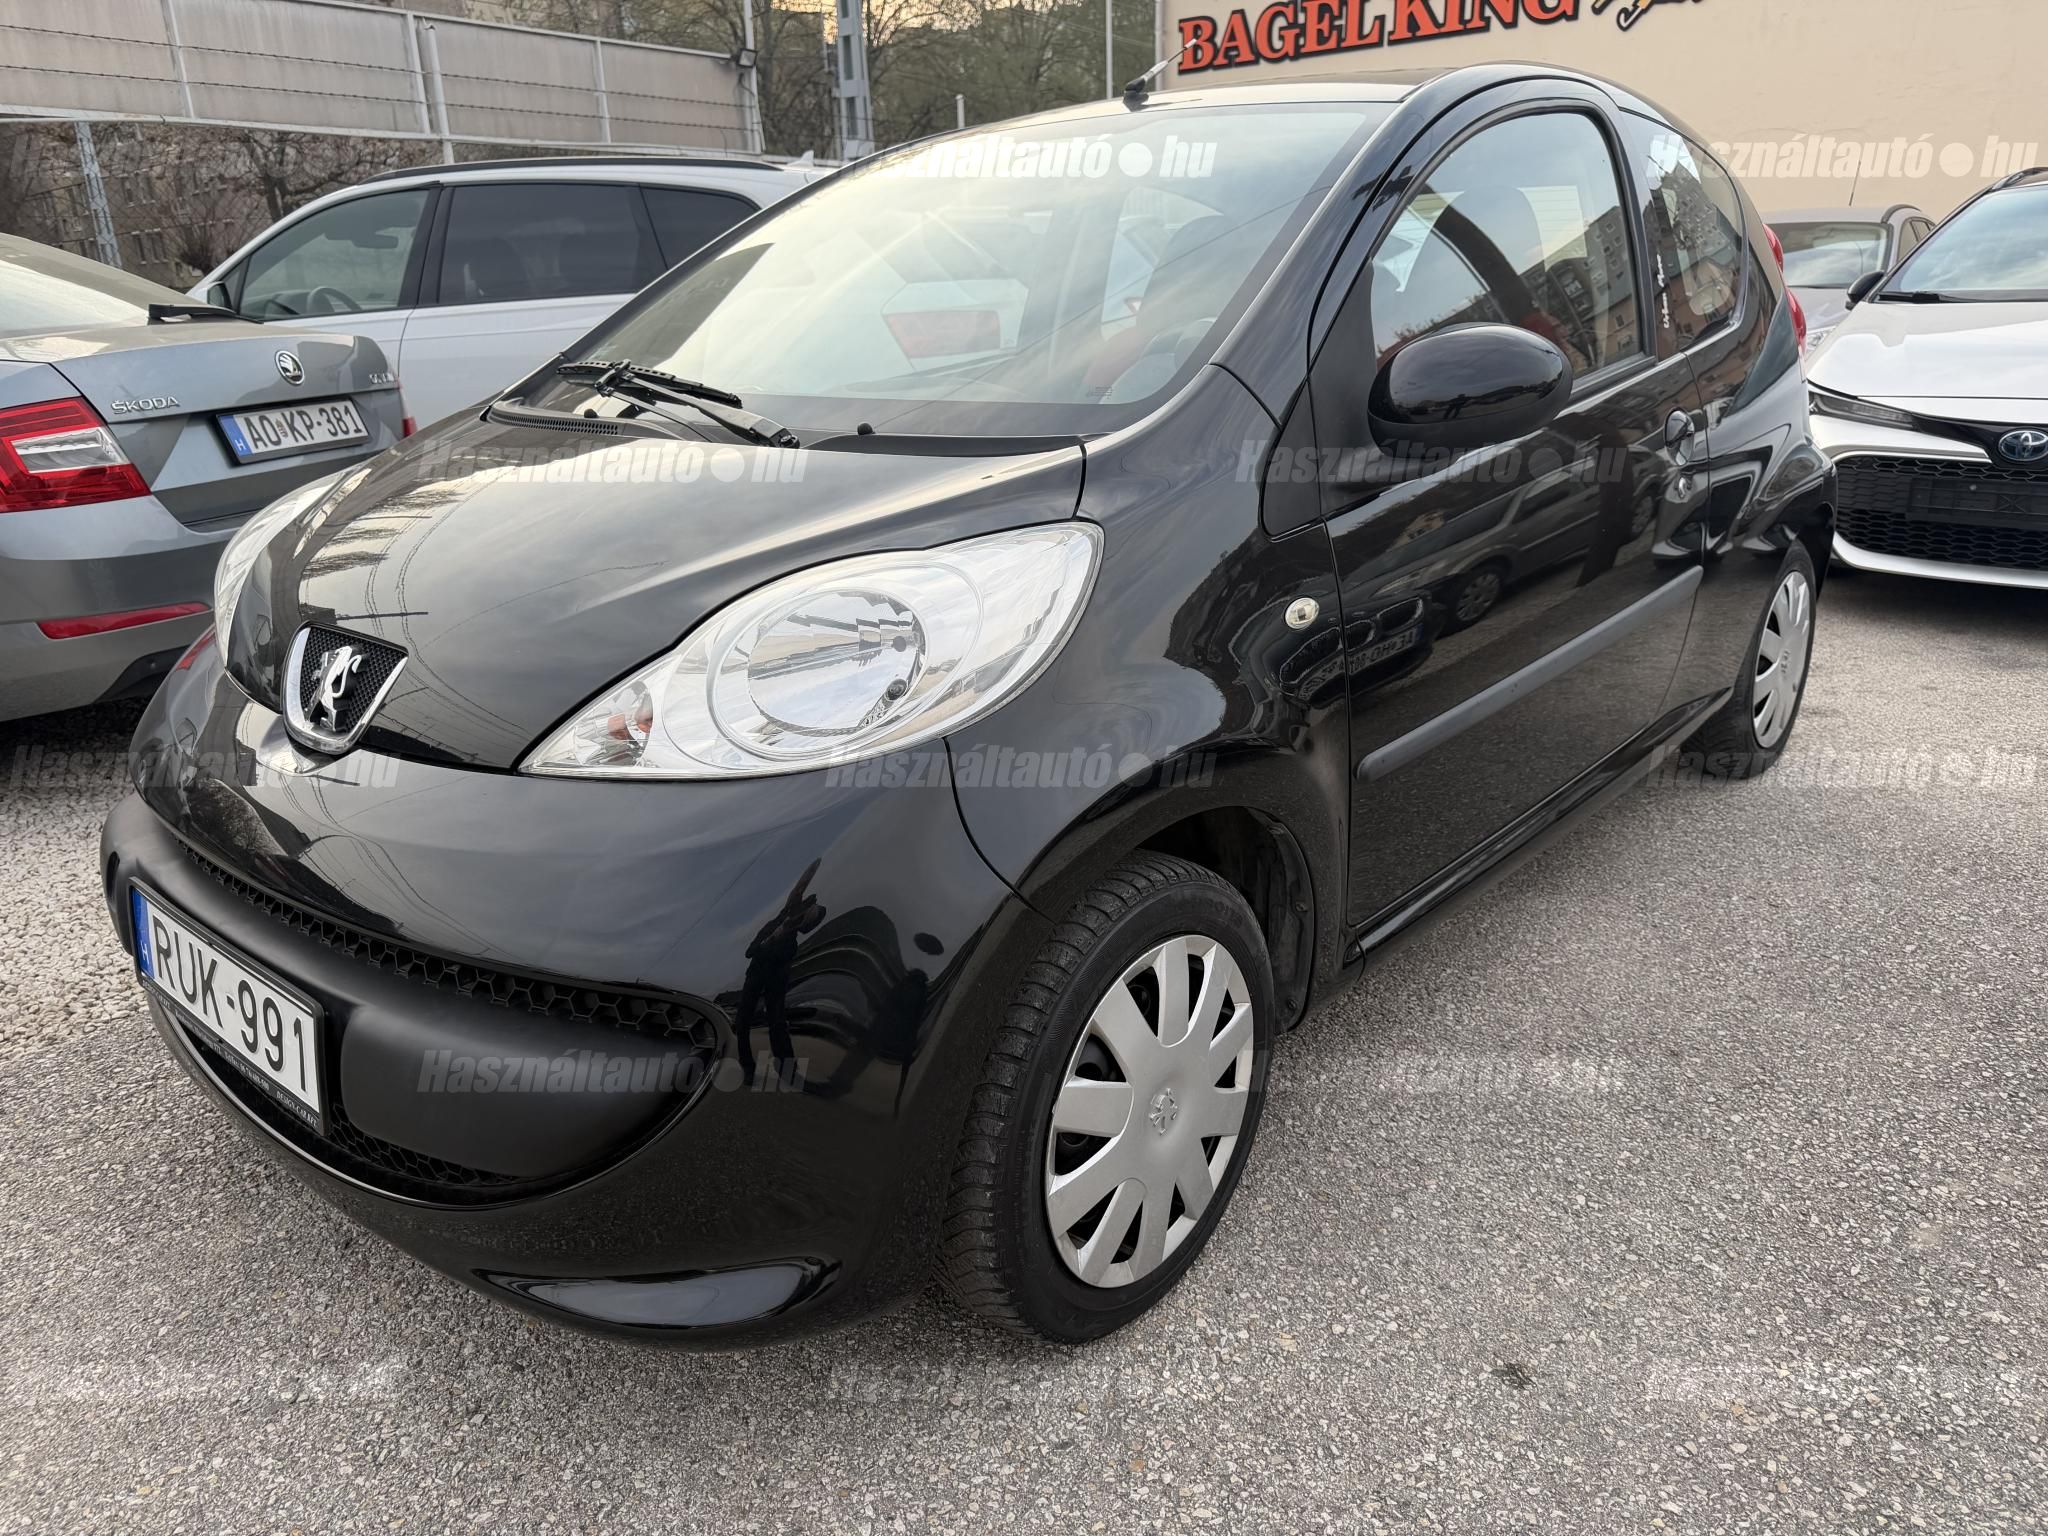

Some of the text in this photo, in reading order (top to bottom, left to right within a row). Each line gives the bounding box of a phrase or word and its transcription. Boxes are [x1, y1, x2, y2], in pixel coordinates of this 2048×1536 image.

[1178, 0, 1385, 75] BAGEL
[111, 396, 180, 415] ŠKODA
[152, 914, 307, 1093] RUK-991
